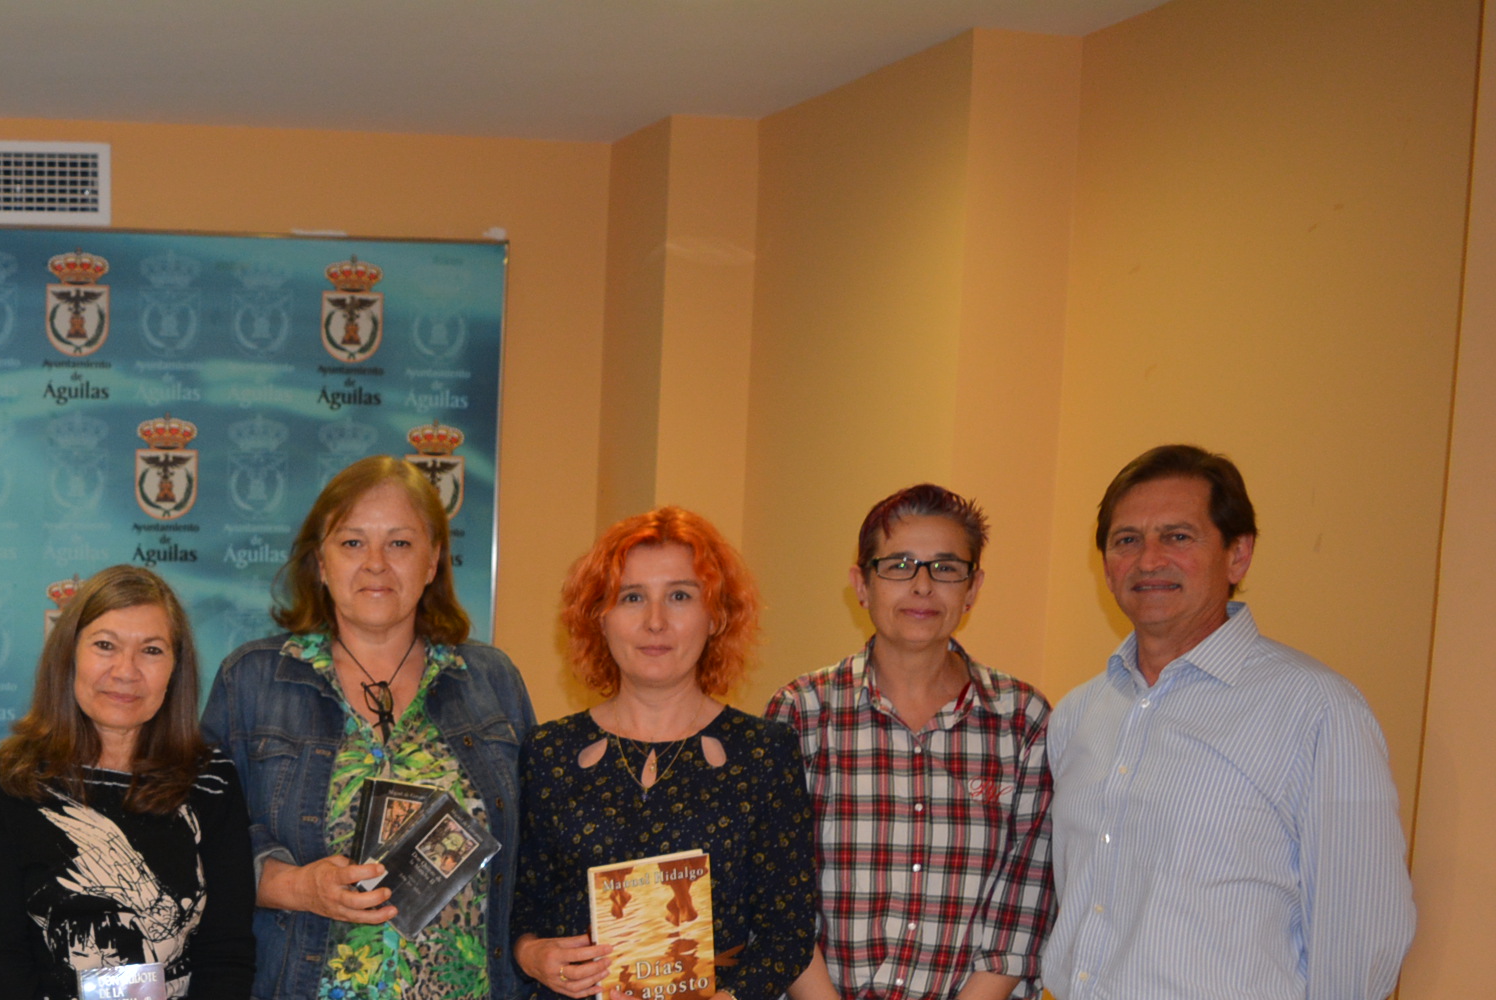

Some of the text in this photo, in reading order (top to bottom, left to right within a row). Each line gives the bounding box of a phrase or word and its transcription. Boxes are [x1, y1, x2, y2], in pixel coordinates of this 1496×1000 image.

[42, 360, 111, 371] Ayuntamiento
[316, 365, 385, 376] Ayuntamiento
[71, 372, 82, 381] de
[344, 377, 355, 387] de
[43, 381, 110, 405] Águilas
[317, 386, 382, 410] Águilas
[406, 390, 468, 412] Águilas
[132, 522, 200, 533] Ayuntamiento
[160, 534, 171, 544] de
[133, 544, 198, 567] Águilas
[224, 545, 288, 569] Águilas
[602, 866, 704, 891] Manuel Hidalgo
[635, 959, 683, 980] Días
[99, 987, 124, 998] DE LA
